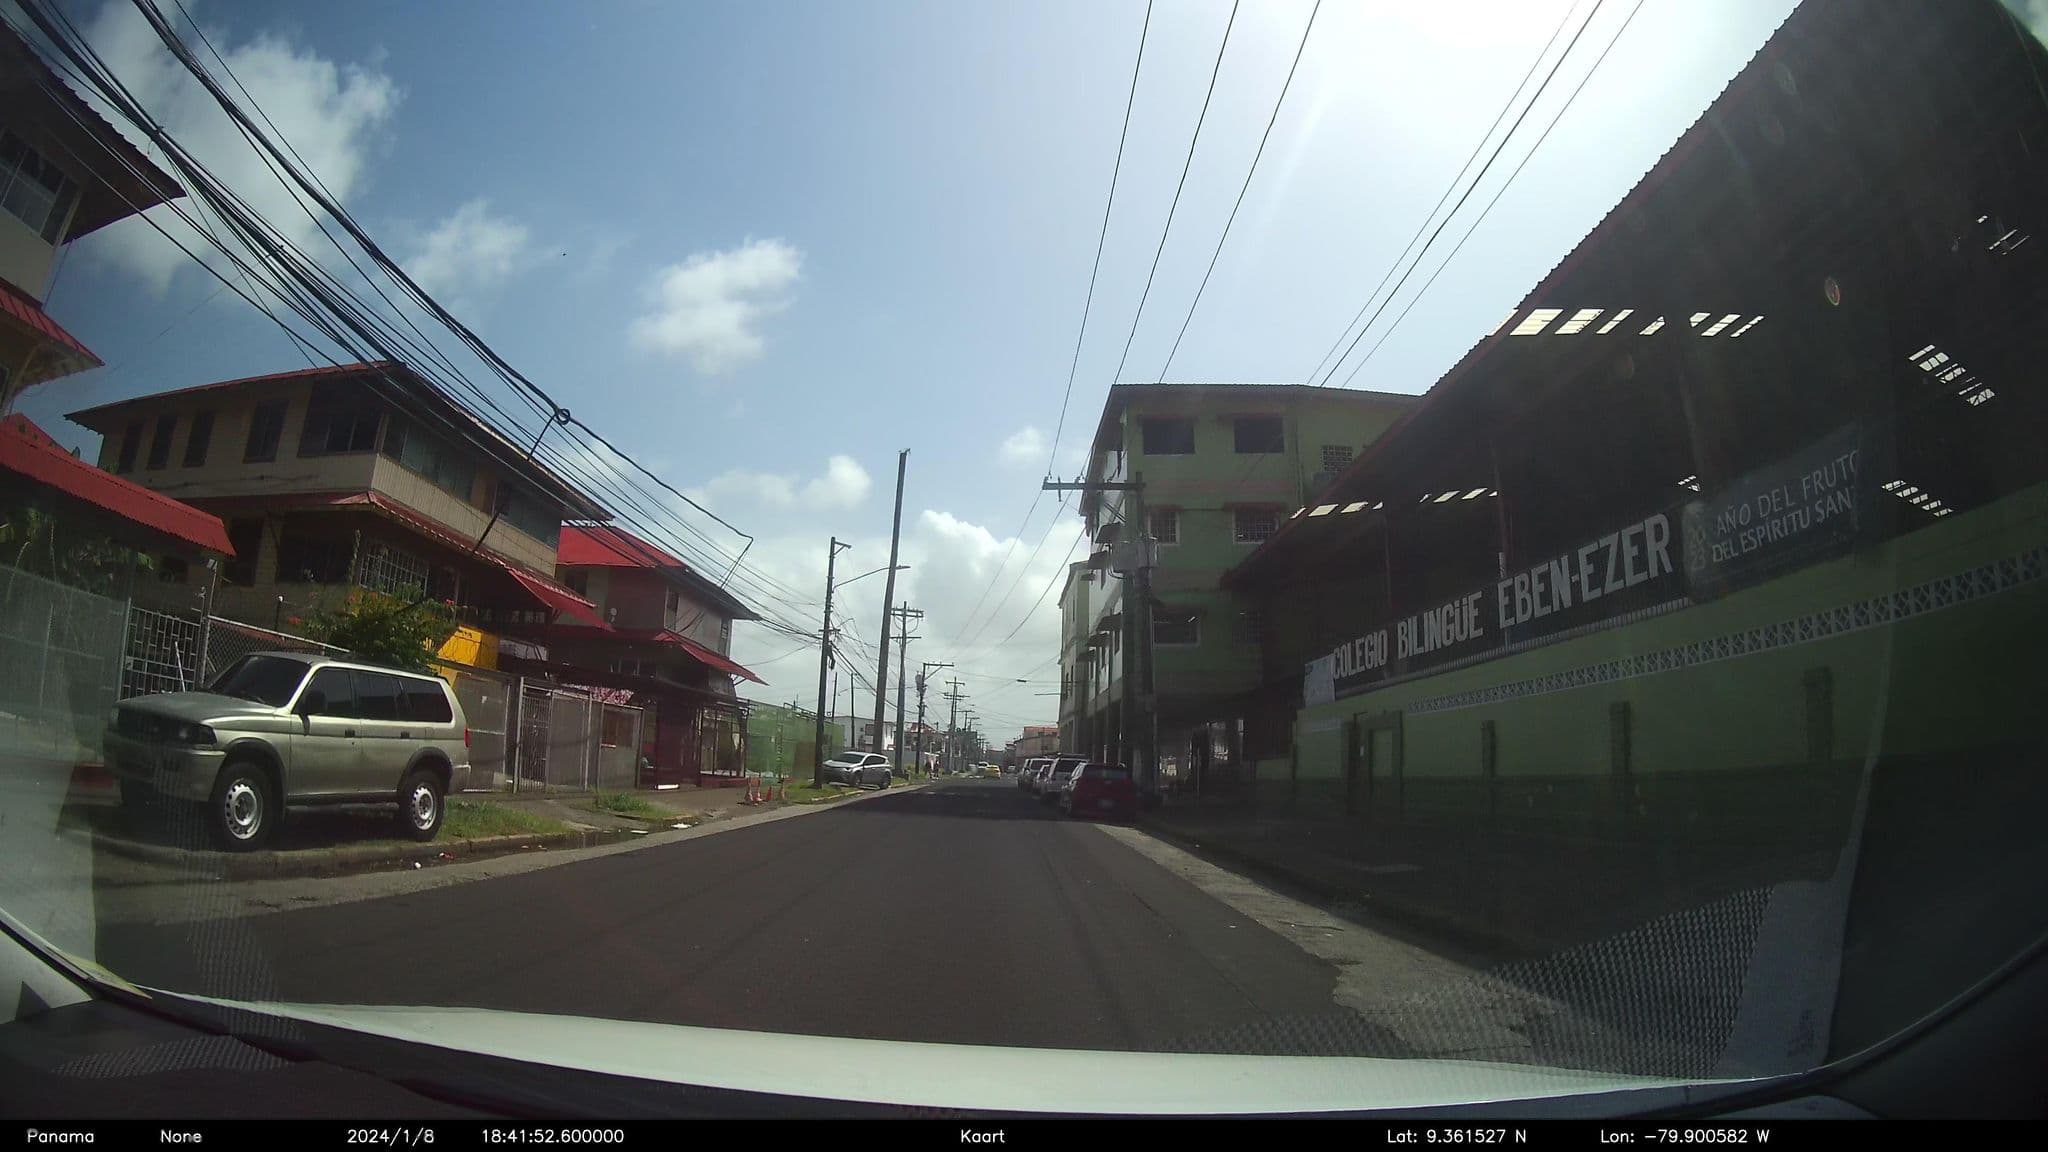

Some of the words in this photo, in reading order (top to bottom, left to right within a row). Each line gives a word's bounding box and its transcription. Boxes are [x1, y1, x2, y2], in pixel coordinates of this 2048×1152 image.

[1712, 543, 1739, 563] DEL
[1741, 505, 1810, 552] ESPÍRITU
[1815, 485, 1855, 523] SAN
[1716, 503, 1751, 537] AÑO
[1757, 484, 1796, 518] DEL
[1333, 629, 1388, 679] COLEGIO
[1397, 591, 1483, 659] BILINGÜE
[1497, 513, 1673, 629] EBEN-EZER
